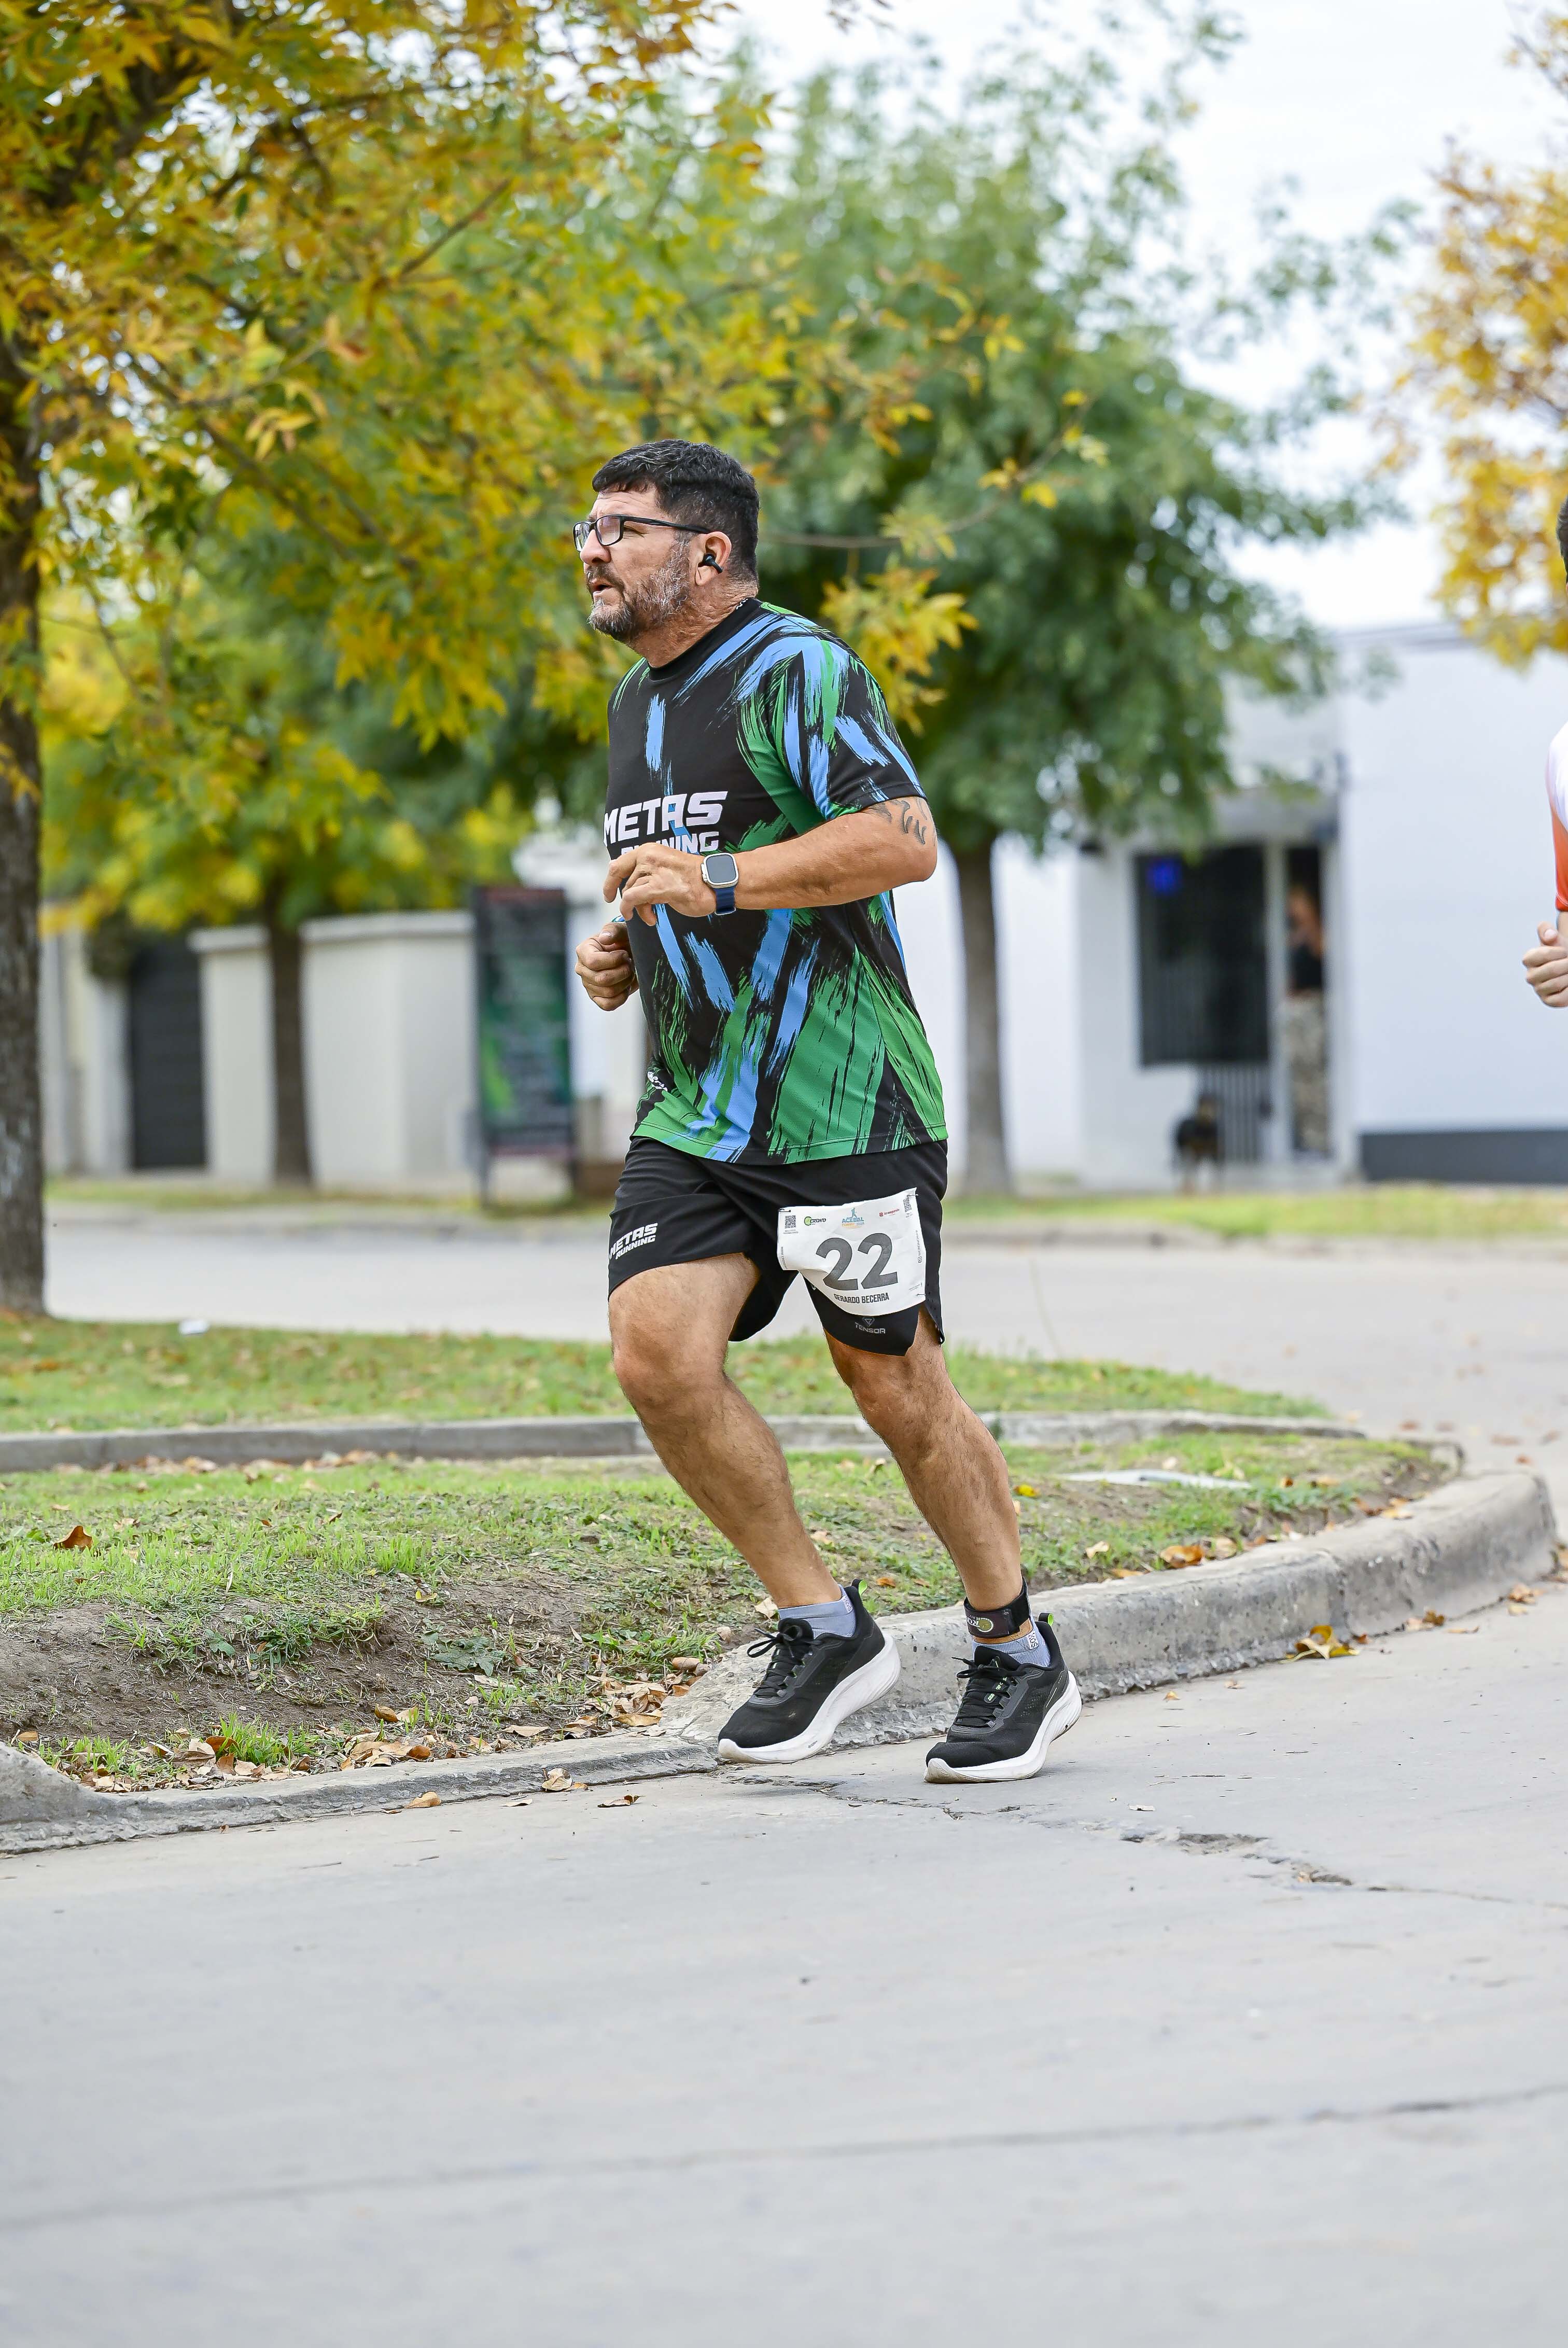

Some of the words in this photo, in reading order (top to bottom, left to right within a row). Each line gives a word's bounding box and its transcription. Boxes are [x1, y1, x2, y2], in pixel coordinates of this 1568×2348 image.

[604, 791, 728, 846] METAS
[610, 1223, 658, 1260] METAS
[615, 1235, 656, 1260] RUNNING
[816, 1233, 898, 1291] 22
[834, 1293, 860, 1304] GERARDO
[861, 1292, 889, 1304] BECERRA
[855, 1322, 886, 1334] TENSOR
